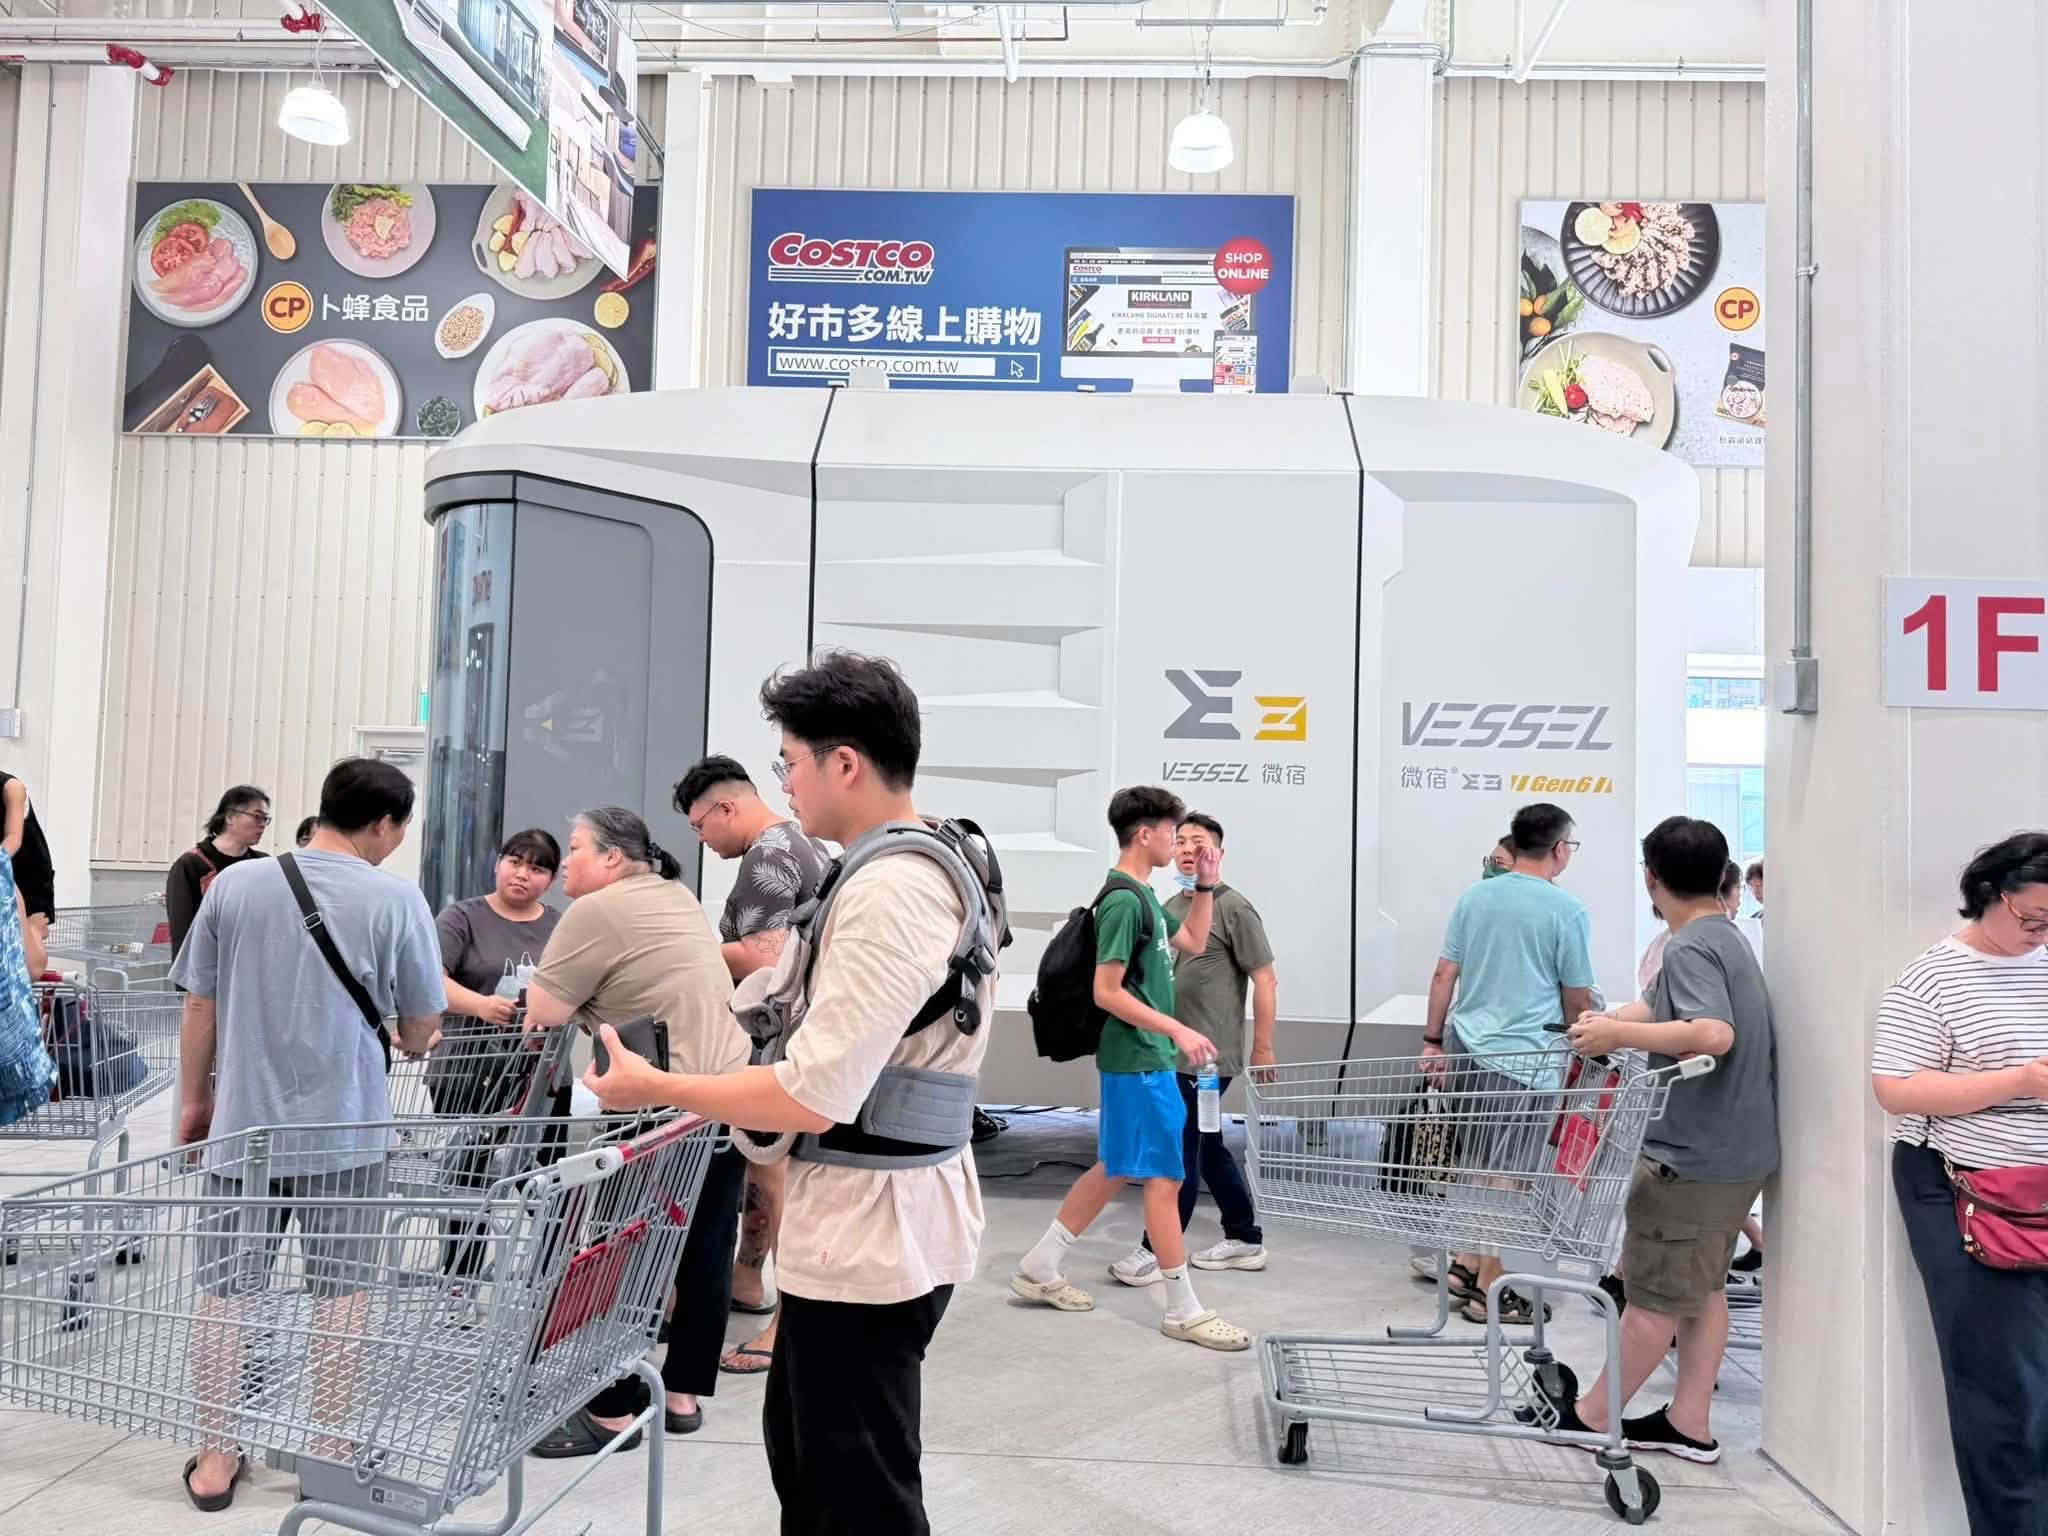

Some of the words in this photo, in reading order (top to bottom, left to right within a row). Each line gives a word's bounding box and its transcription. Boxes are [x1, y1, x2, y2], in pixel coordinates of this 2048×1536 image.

[1225, 253, 1263, 264] SHOP
[1218, 267, 1270, 281] ONLINE
[269, 296, 306, 319] CP
[322, 293, 429, 322] 卜蜂食品
[1131, 291, 1190, 303] KIRKLAND
[1719, 299, 1754, 319] CP
[768, 300, 1042, 347] 好市多線上購物
[1903, 594, 2046, 693] 1F
[1401, 701, 1613, 751] VESSEL
[1162, 761, 1250, 783] VESSEL
[1262, 762, 1306, 786] 微宿
